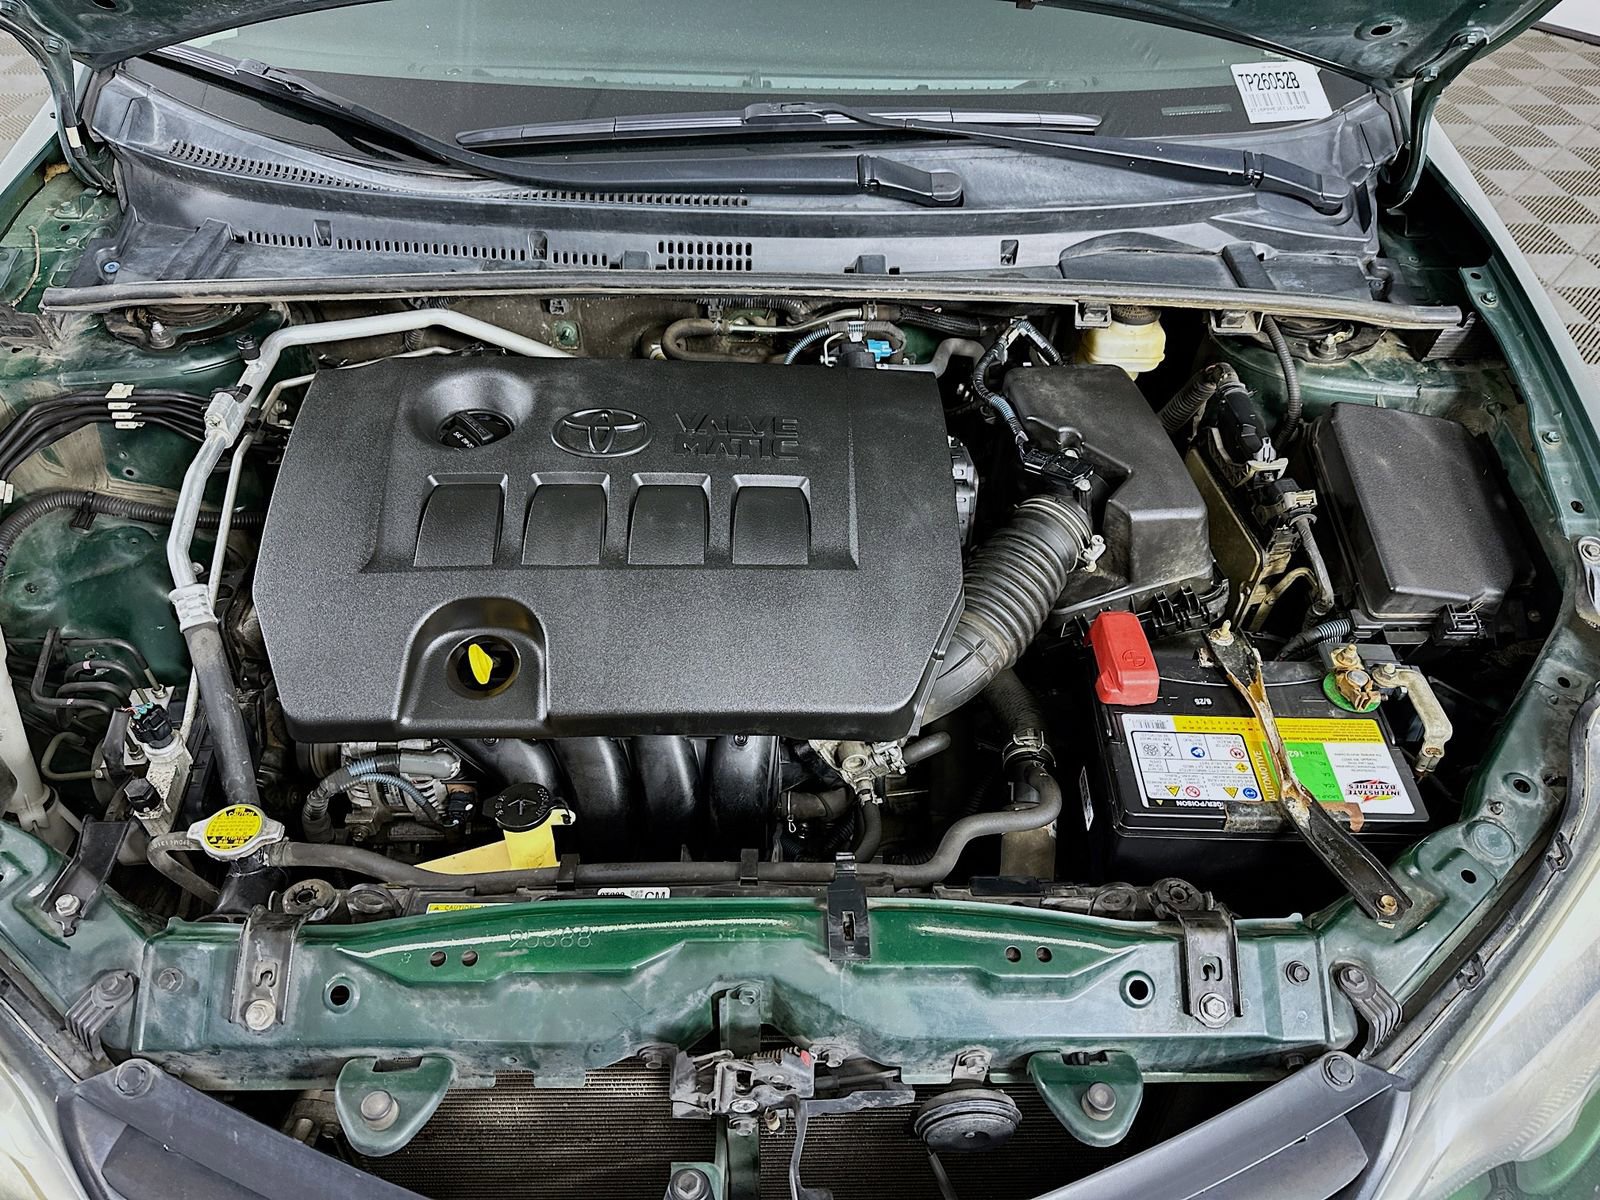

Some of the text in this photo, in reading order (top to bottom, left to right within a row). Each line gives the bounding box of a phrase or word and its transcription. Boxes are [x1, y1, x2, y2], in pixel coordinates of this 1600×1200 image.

[1237, 71, 1300, 92] TP26052B
[674, 412, 799, 437] VALVE
[674, 438, 800, 461] MATIC
[1252, 750, 1277, 801] AUTOMOTIVE
